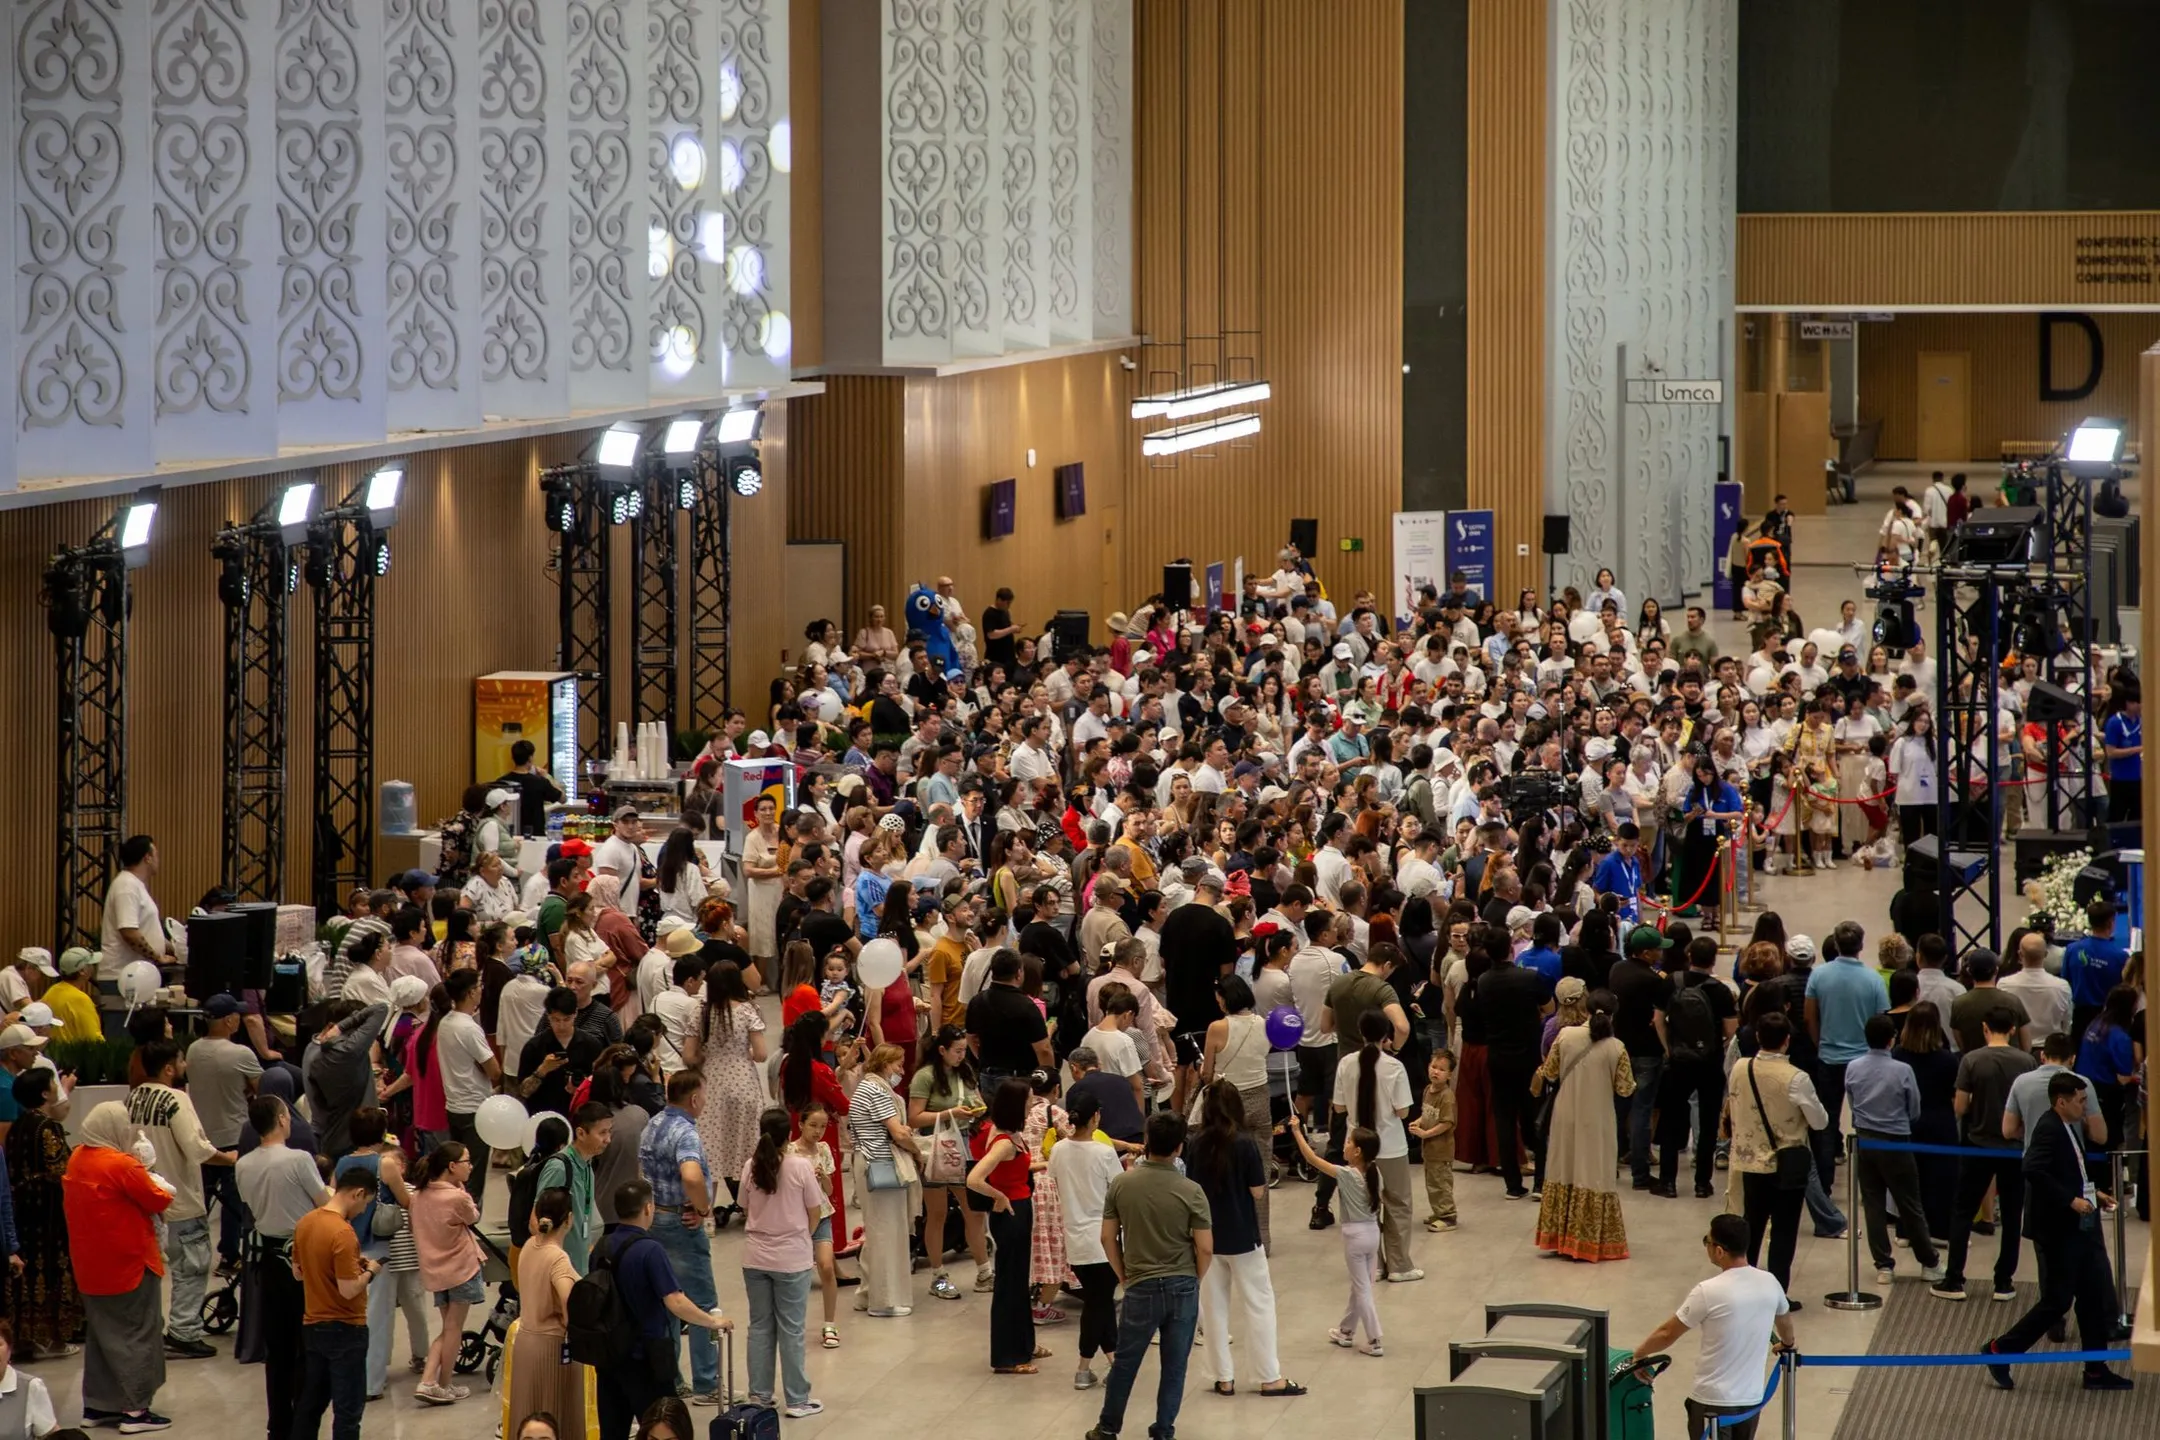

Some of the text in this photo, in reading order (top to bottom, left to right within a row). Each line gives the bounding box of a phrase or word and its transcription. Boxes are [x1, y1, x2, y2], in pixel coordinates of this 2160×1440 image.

[2076, 236, 2160, 248] KONFERENC-Z
[2076, 272, 2151, 284] CONFERENCE
[1803, 325, 1821, 336] WC
[2039, 312, 2104, 401] D
[1662, 383, 1714, 401] bmca
[743, 770, 763, 781] Red
